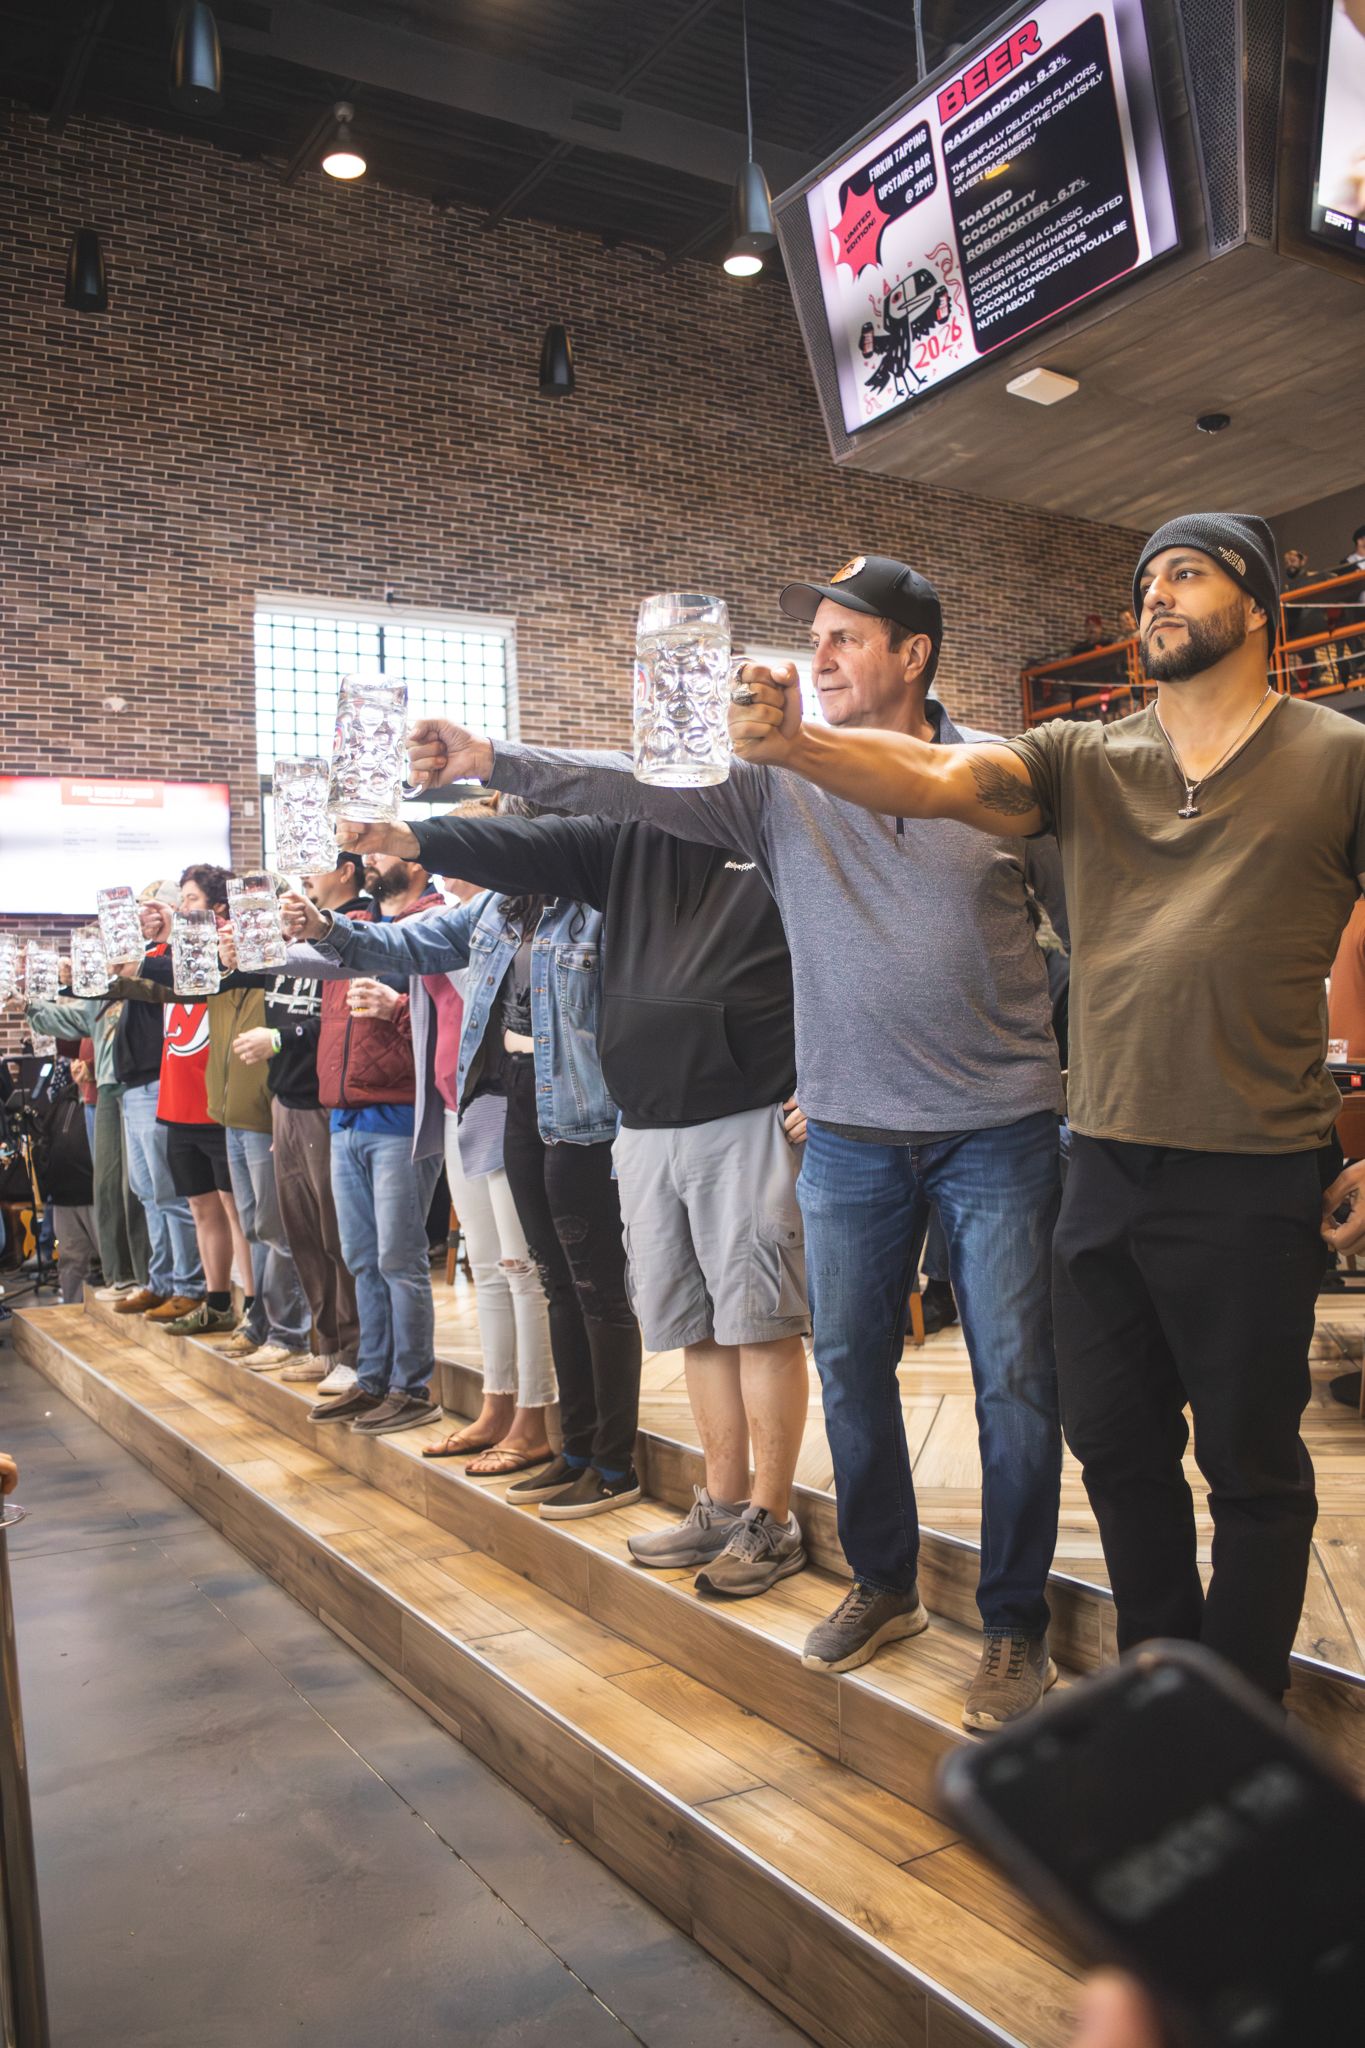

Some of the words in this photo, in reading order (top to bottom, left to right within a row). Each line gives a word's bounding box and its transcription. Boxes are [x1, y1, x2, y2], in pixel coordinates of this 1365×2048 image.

[937, 20, 1042, 126] BEER
[944, 80, 1030, 154] RAZZBADDON
[1037, 54, 1068, 82] 8.3%
[951, 157, 968, 173] THE
[968, 129, 1005, 162] SINFULLY
[1006, 95, 1052, 134] DELICIOUS
[1053, 63, 1097, 103] FLAVORS
[953, 172, 965, 185] OF
[966, 141, 1008, 177] ABADDON
[1008, 123, 1032, 146] MEET
[1033, 111, 1051, 127] THE
[1052, 71, 1103, 115] DEVILISHLY
[869, 154, 894, 182] FIRKIN
[893, 129, 927, 162] TAPPING
[878, 165, 914, 200] UPSTAIRS
[914, 152, 931, 174] BAR
[955, 172, 985, 197] SWEET
[984, 133, 1037, 176] RASPBERRY
[905, 188, 914, 203] @
[914, 173, 934, 196] 2PM!
[959, 190, 1013, 230] TOASTED
[962, 190, 1036, 245] COCONUTTY
[844, 210, 871, 244] LIMITED
[966, 200, 1049, 262] ROBOPORTER
[968, 265, 992, 284] DARK
[992, 243, 1026, 269] GRAINS
[1025, 236, 1035, 248] IN
[1035, 232, 1043, 242] A
[1043, 206, 1083, 236] CLASSIC
[970, 270, 1005, 295] PORTER
[1005, 258, 1025, 274] PAIR
[1025, 242, 1050, 261] WITH
[1051, 224, 1078, 246] HAND
[1078, 195, 1123, 228] TOASTED
[972, 275, 1016, 306] COCONUT
[1016, 268, 1029, 280] TO
[1029, 247, 1065, 272] CREATE
[1065, 232, 1087, 249] THIS
[975, 287, 1018, 318] COCONUT
[1018, 250, 1081, 291] CONCOCTION
[1113, 221, 1128, 235] BE
[976, 308, 1005, 331] NUTTY
[1005, 290, 1036, 314] ABOUT
[914, 316, 962, 369] 2026
